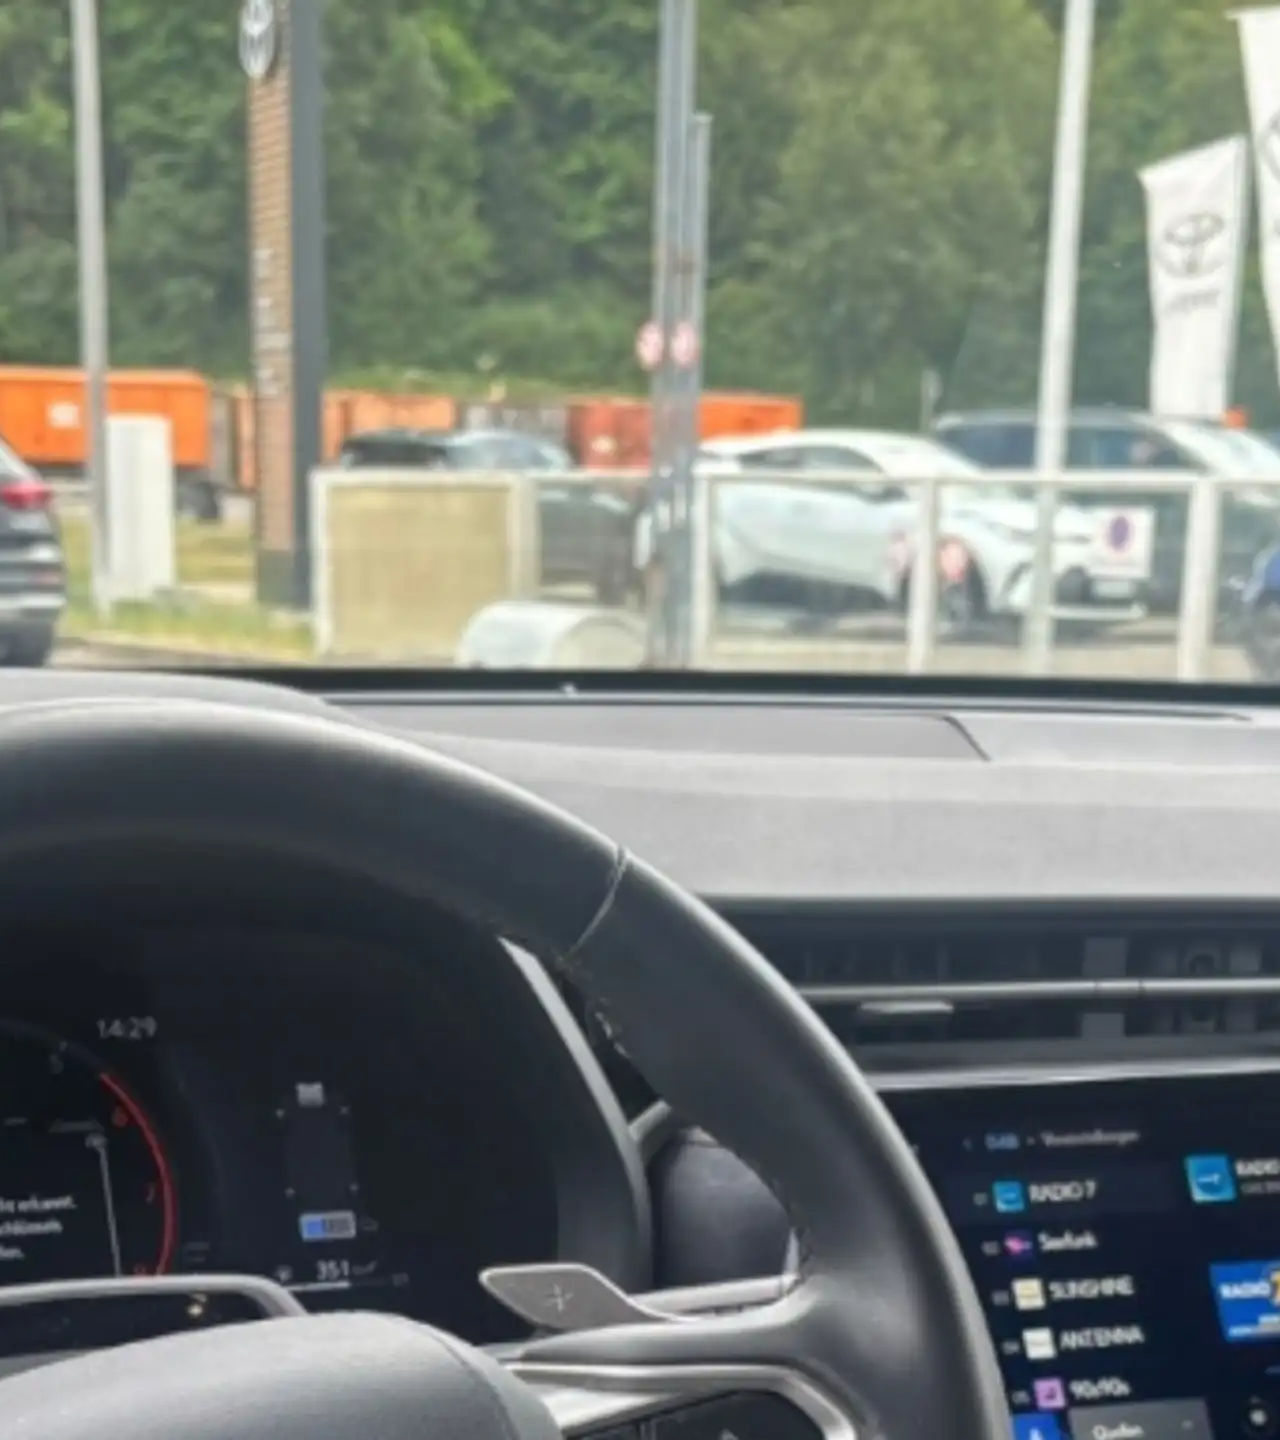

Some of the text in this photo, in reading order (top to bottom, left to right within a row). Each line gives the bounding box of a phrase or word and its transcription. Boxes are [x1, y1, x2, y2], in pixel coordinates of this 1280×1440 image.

[97, 1016, 157, 1039] 14:29
[1029, 1182, 1082, 1203] RADIO
[316, 1259, 350, 1280] 351
[1060, 1326, 1144, 1350] ANTENNA
